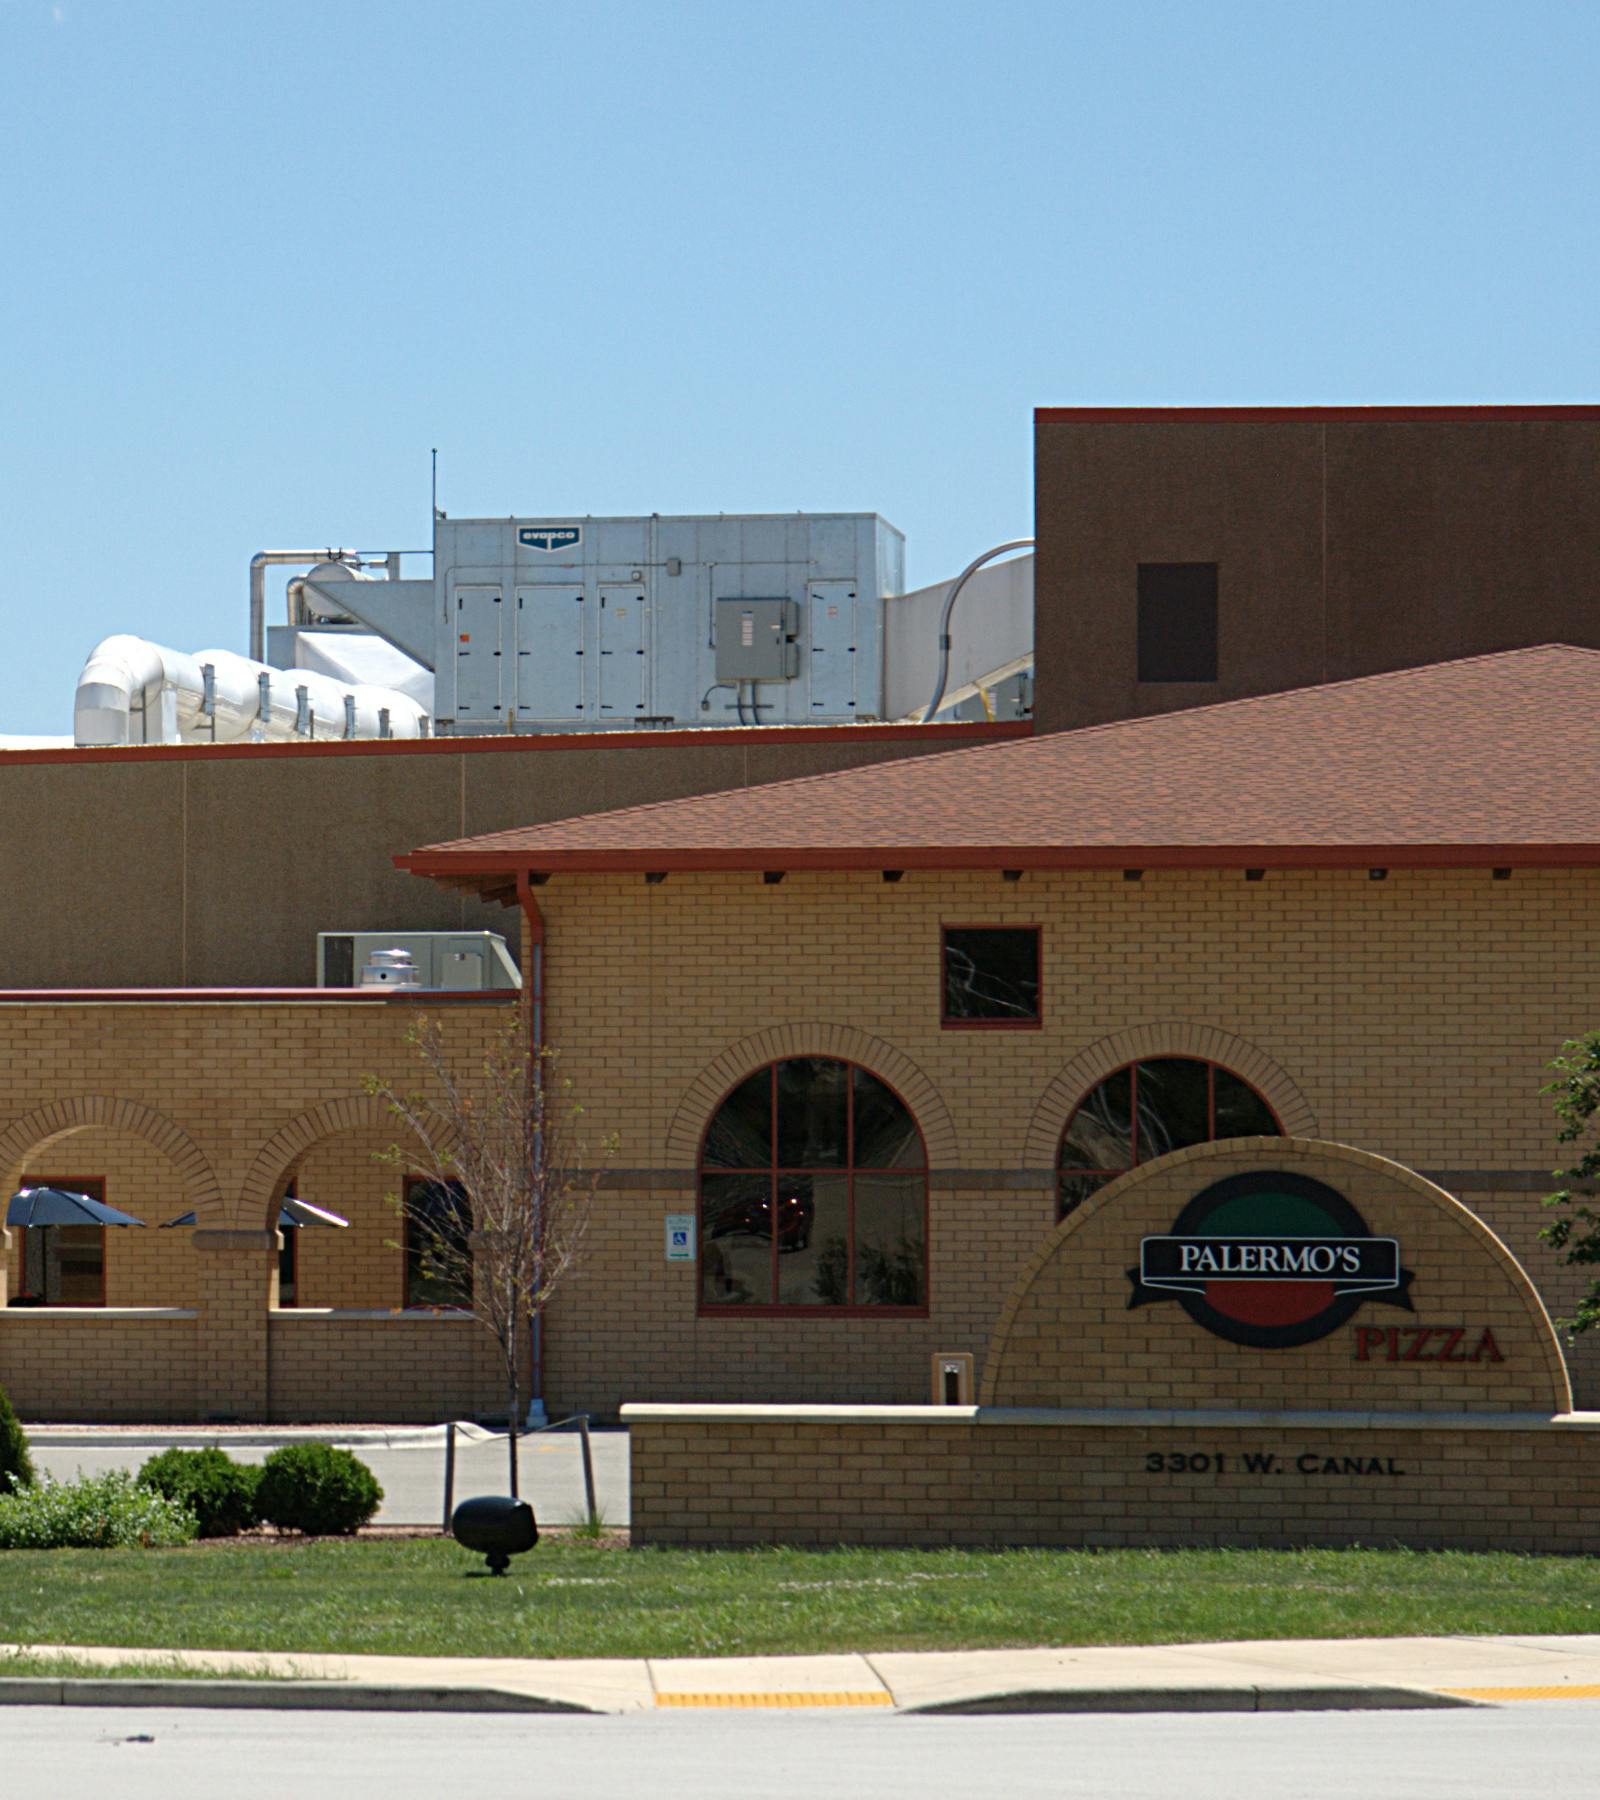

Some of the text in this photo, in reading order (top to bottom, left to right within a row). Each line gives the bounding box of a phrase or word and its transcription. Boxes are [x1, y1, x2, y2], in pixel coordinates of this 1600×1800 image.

[1179, 1244, 1361, 1273] PALERMO'S
[1354, 1326, 1505, 1363] PIZZA
[1145, 1452, 1406, 1476] 3301 W. CANAL
